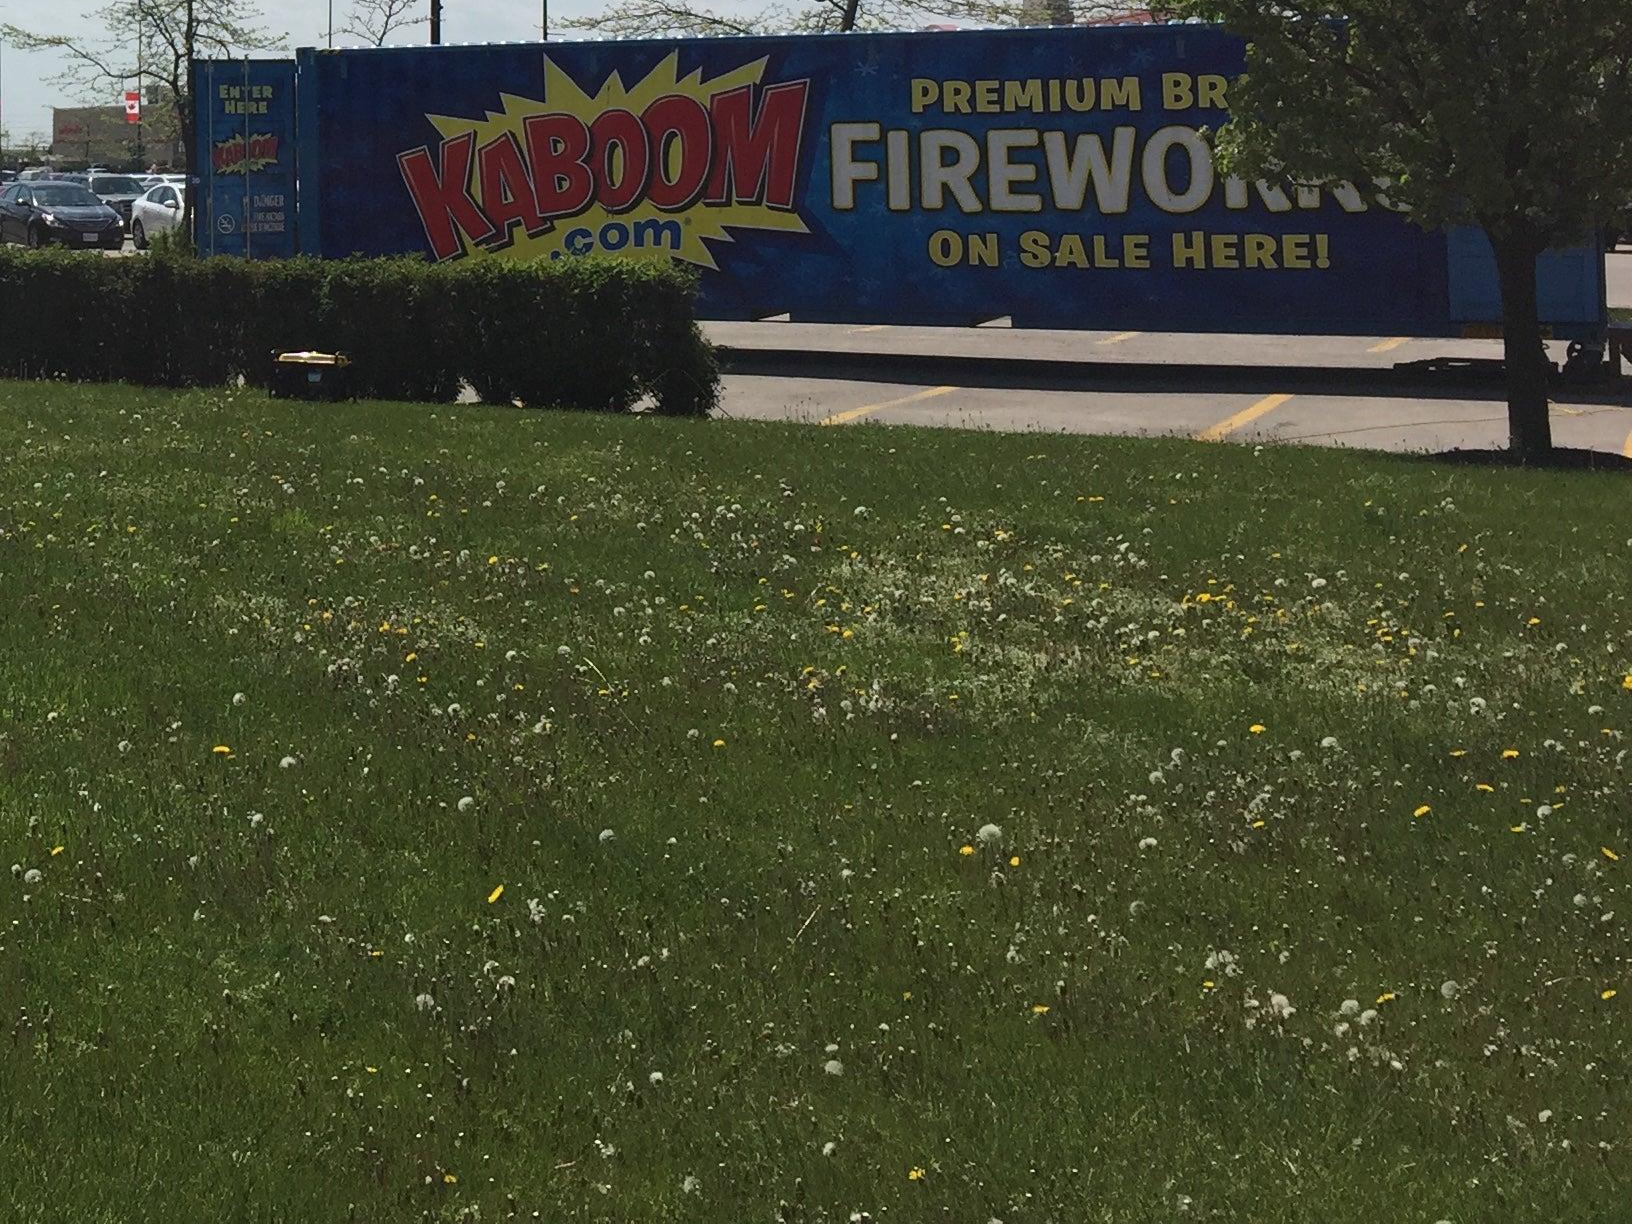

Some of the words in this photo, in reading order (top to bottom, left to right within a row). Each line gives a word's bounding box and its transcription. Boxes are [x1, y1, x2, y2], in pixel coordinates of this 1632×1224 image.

[224, 100, 268, 114] HERE
[911, 76, 1142, 114] PREMIUM
[1161, 72, 1229, 110] BR
[395, 78, 810, 263] KABOOM
[928, 229, 1000, 267] ON
[1019, 230, 1151, 269] SALE
[1172, 231, 1331, 269] HERE!
